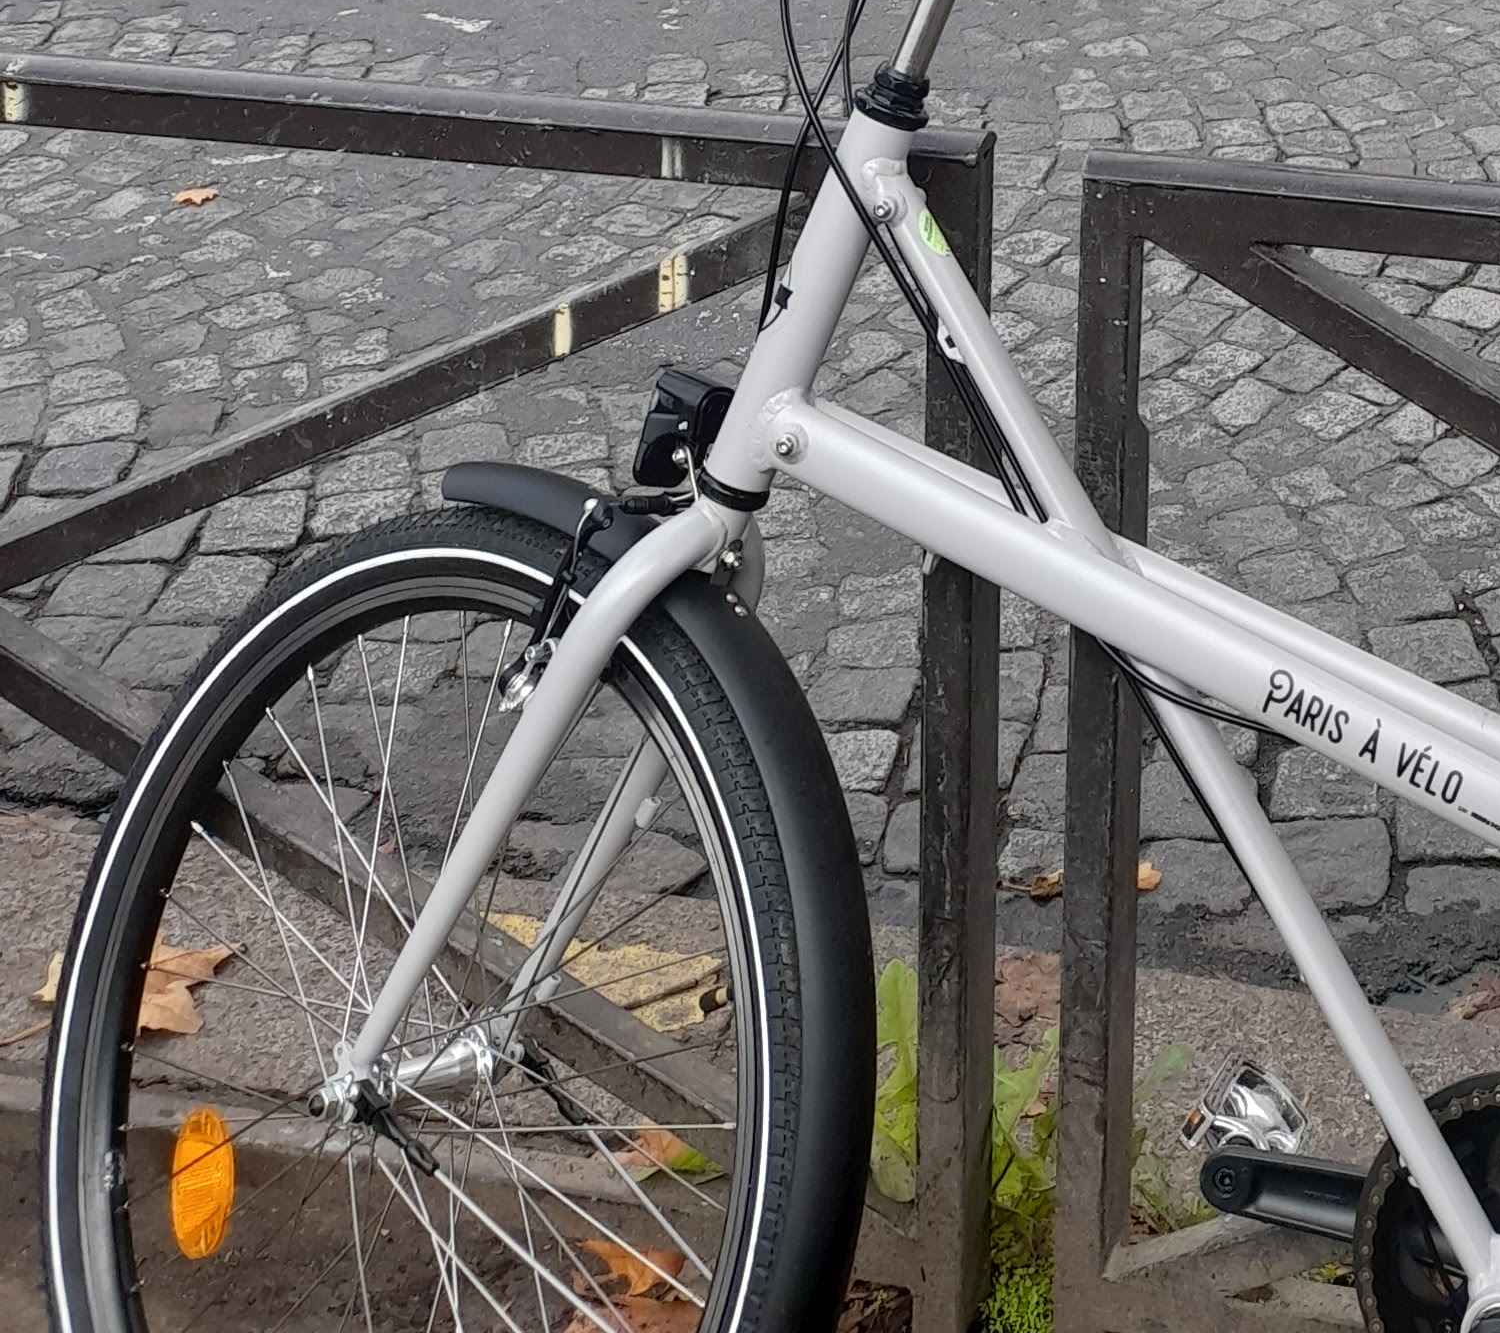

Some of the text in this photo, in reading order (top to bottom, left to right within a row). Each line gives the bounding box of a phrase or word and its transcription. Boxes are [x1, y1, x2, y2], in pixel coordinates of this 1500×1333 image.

[1262, 669, 1463, 805] PARIS À VÉLO
